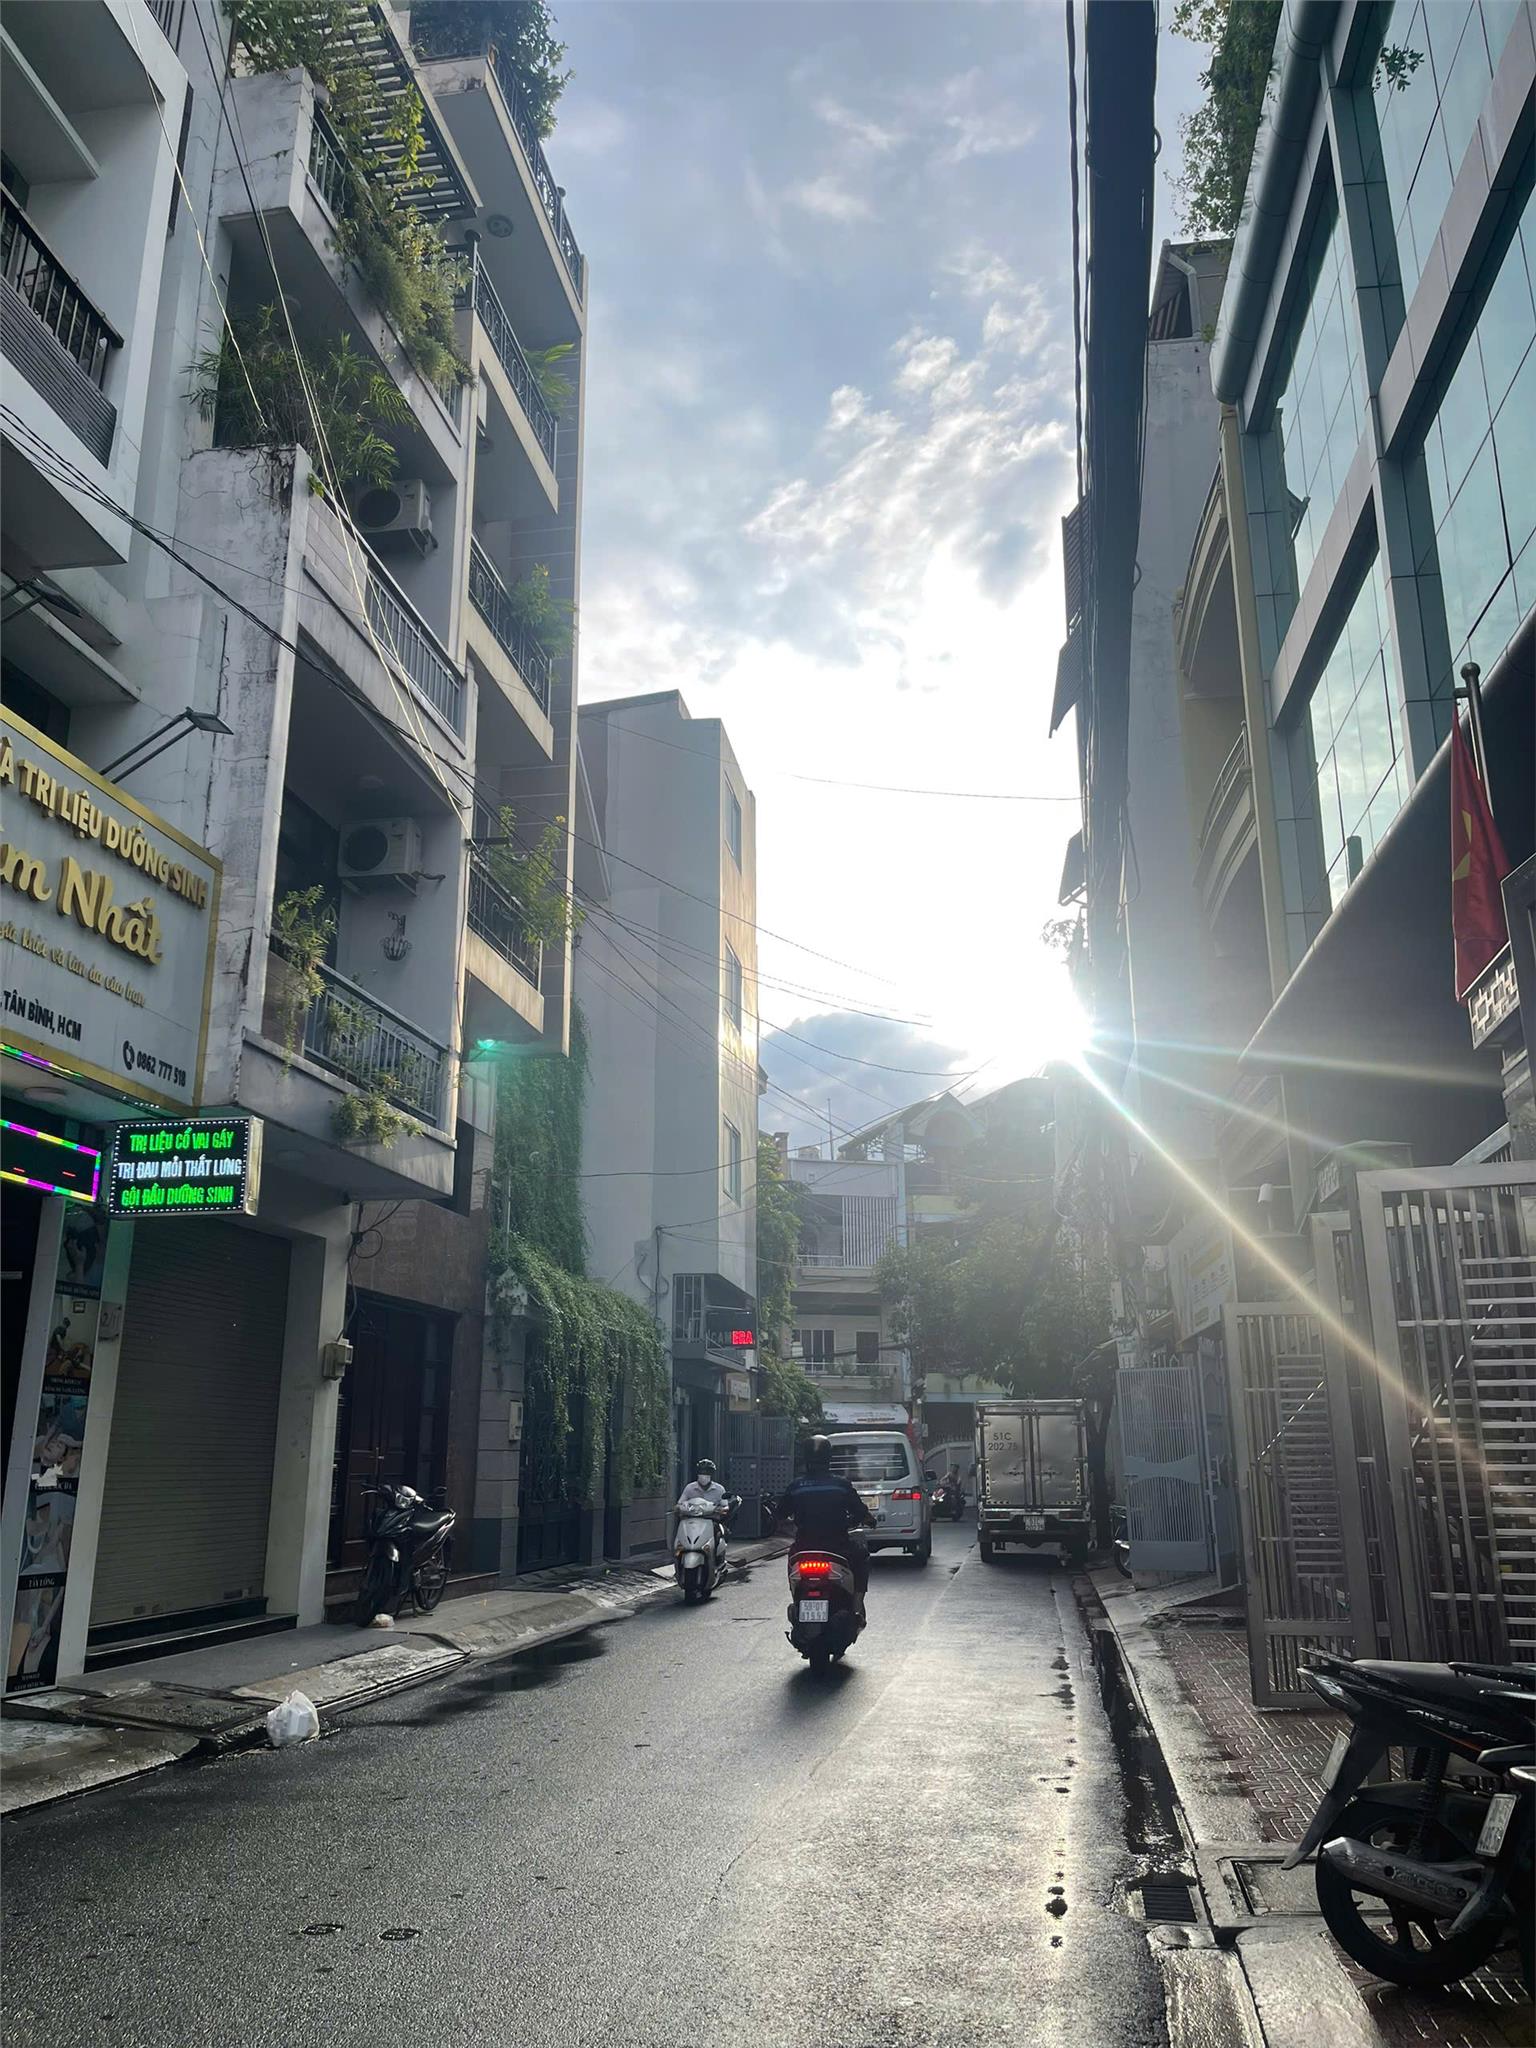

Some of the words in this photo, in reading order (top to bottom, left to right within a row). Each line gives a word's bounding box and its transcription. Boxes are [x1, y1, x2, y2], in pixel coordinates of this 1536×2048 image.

[18, 759, 57, 817] TRỊ
[59, 786, 103, 839] LIỆU
[170, 863, 208, 910] SINH
[59, 855, 163, 965] Nhất
[4, 989, 27, 1019] TÂN
[27, 999, 56, 1035] BÌNH,
[57, 1014, 82, 1042] HCM
[136, 1051, 157, 1076] 0862
[158, 1061, 173, 1082] 777
[130, 1134, 148, 1154] TRỊ
[149, 1129, 174, 1154] LIỆU
[192, 1132, 210, 1149] VAI
[212, 1128, 235, 1149] GÁY
[118, 1162, 135, 1182] TRỊ
[136, 1160, 160, 1179] ĐAU
[121, 1185, 141, 1209] GỘI
[206, 1185, 234, 1204] SINH
[993, 1432, 1012, 1441] 51C
